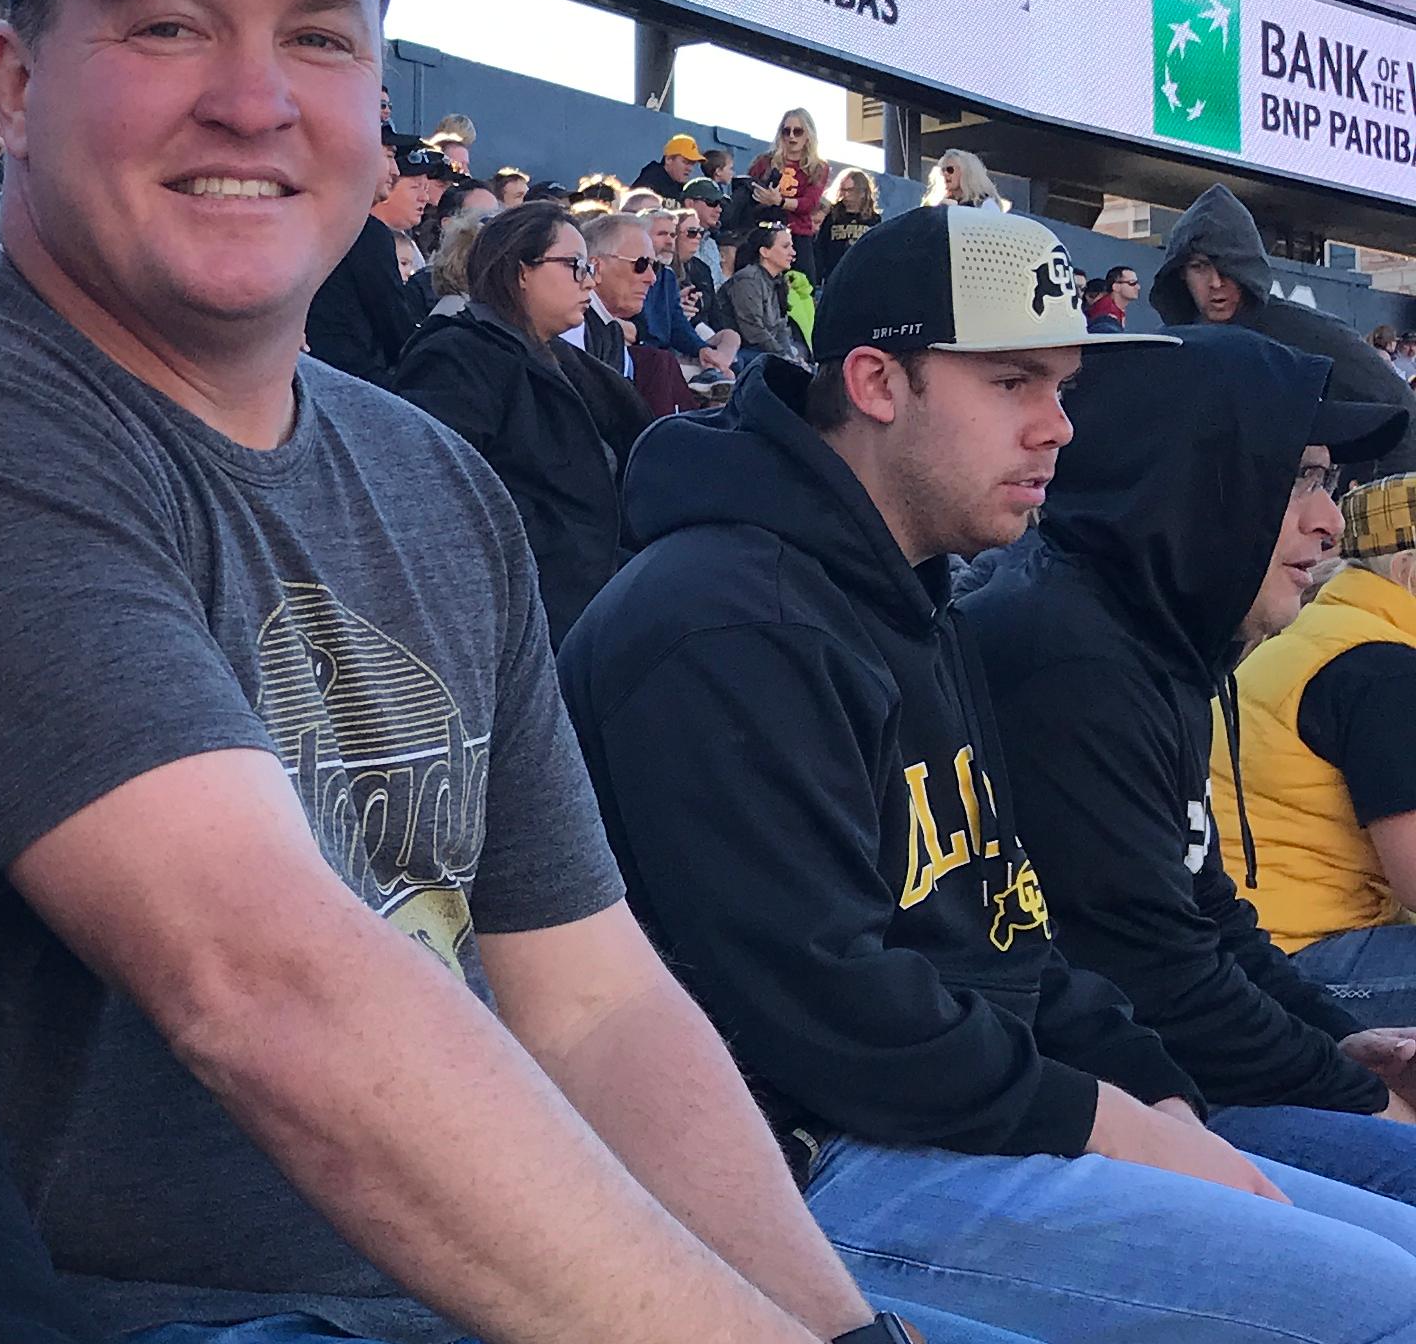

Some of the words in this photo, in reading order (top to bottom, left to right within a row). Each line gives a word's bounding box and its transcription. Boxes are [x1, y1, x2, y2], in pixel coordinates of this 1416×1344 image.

[1261, 19, 1370, 104] BANK
[1377, 56, 1400, 84] OF
[1371, 82, 1405, 115] THE
[1261, 92, 1321, 141] BNP
[1329, 110, 1416, 168] PARIB
[871, 322, 925, 341] DRI-FIT
